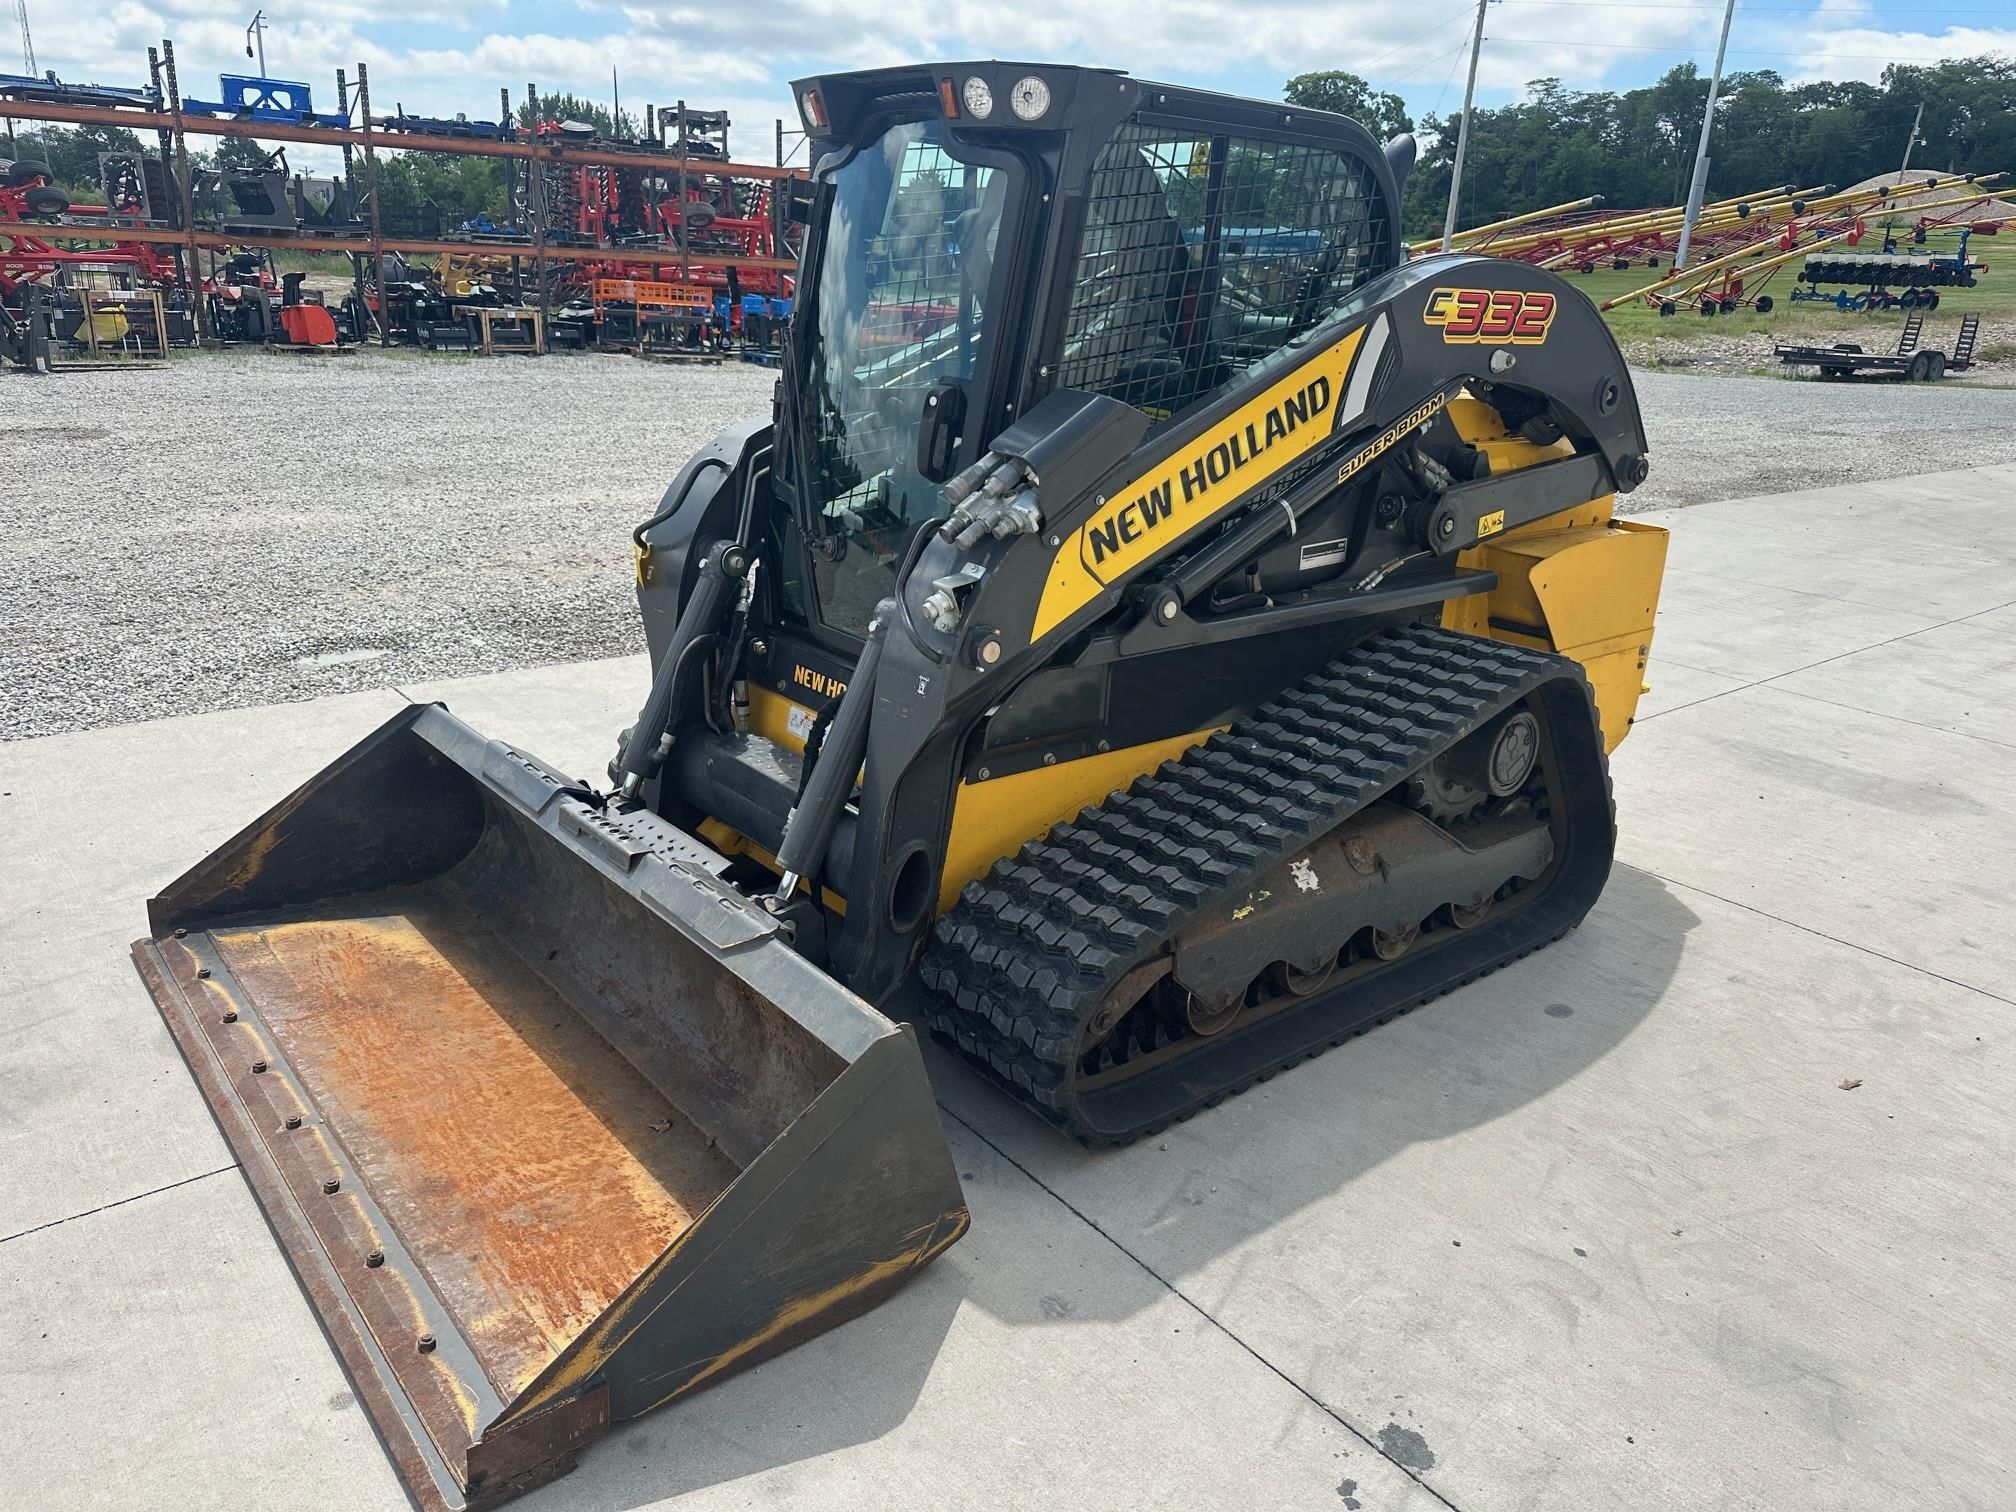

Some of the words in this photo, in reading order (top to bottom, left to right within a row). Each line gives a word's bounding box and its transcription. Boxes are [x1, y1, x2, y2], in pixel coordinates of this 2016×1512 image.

[1423, 287, 1557, 345] C332
[1088, 478, 1174, 566] NEW
[1179, 374, 1331, 504] HOLLAND
[1337, 429, 1396, 485] SUPER
[1395, 391, 1445, 441] BOOM
[793, 664, 826, 693] NEW
